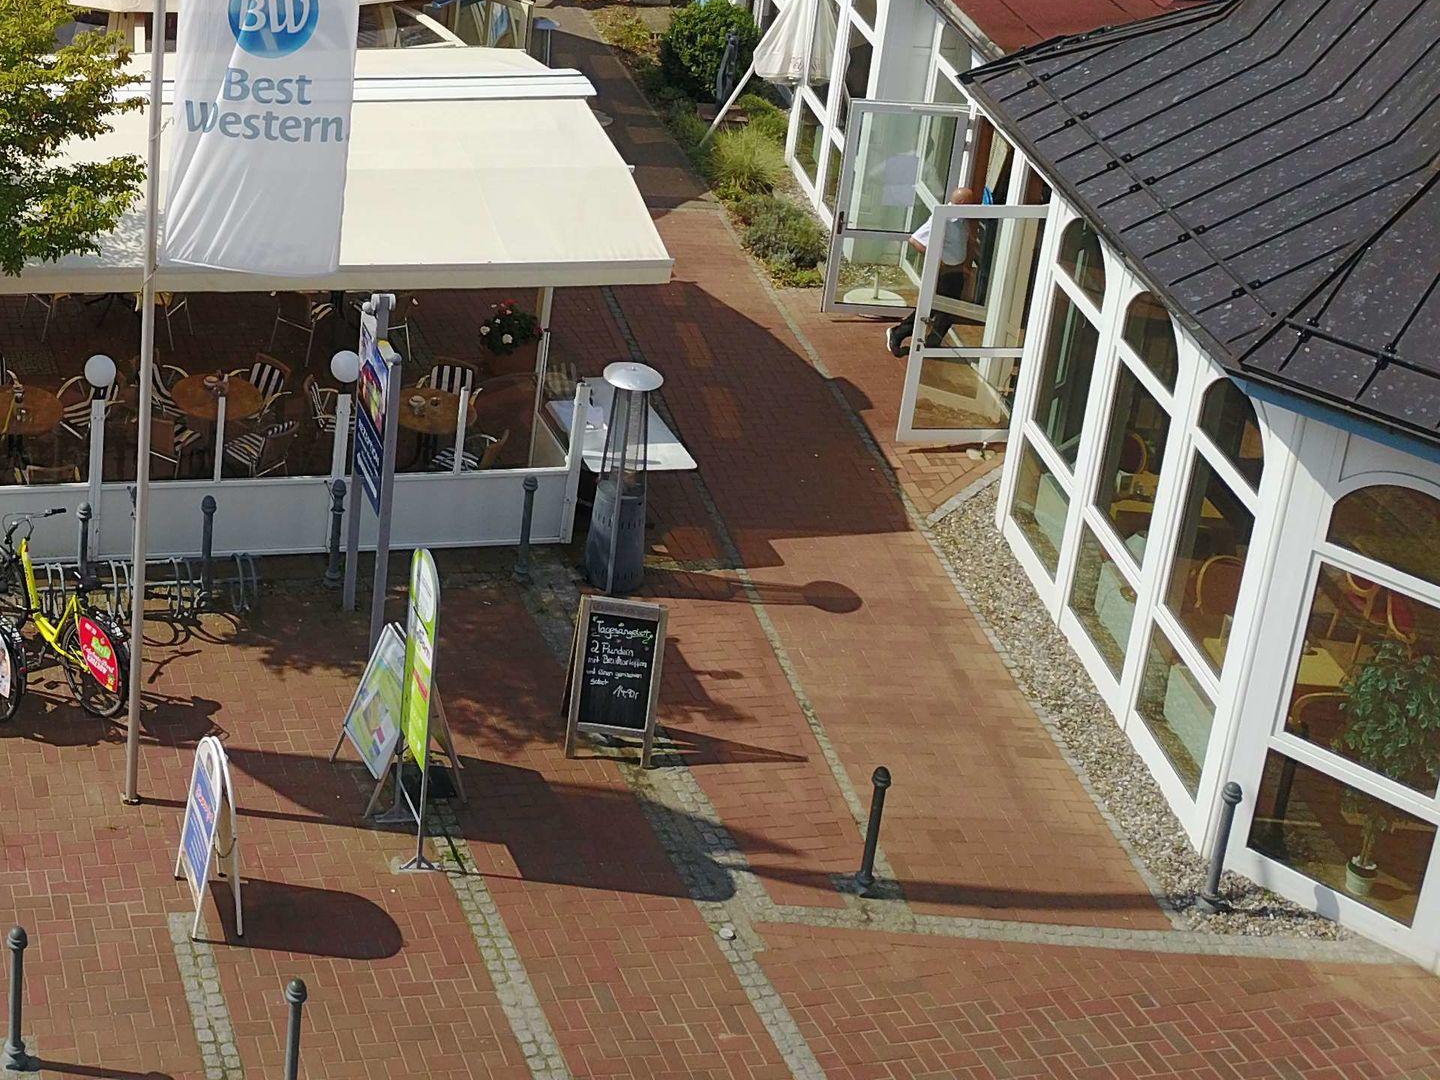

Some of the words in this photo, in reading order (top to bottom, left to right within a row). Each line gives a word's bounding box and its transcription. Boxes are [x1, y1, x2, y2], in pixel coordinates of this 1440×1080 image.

[222, 67, 312, 105] Best
[185, 100, 343, 142] Western
[590, 639, 599, 653] 2
